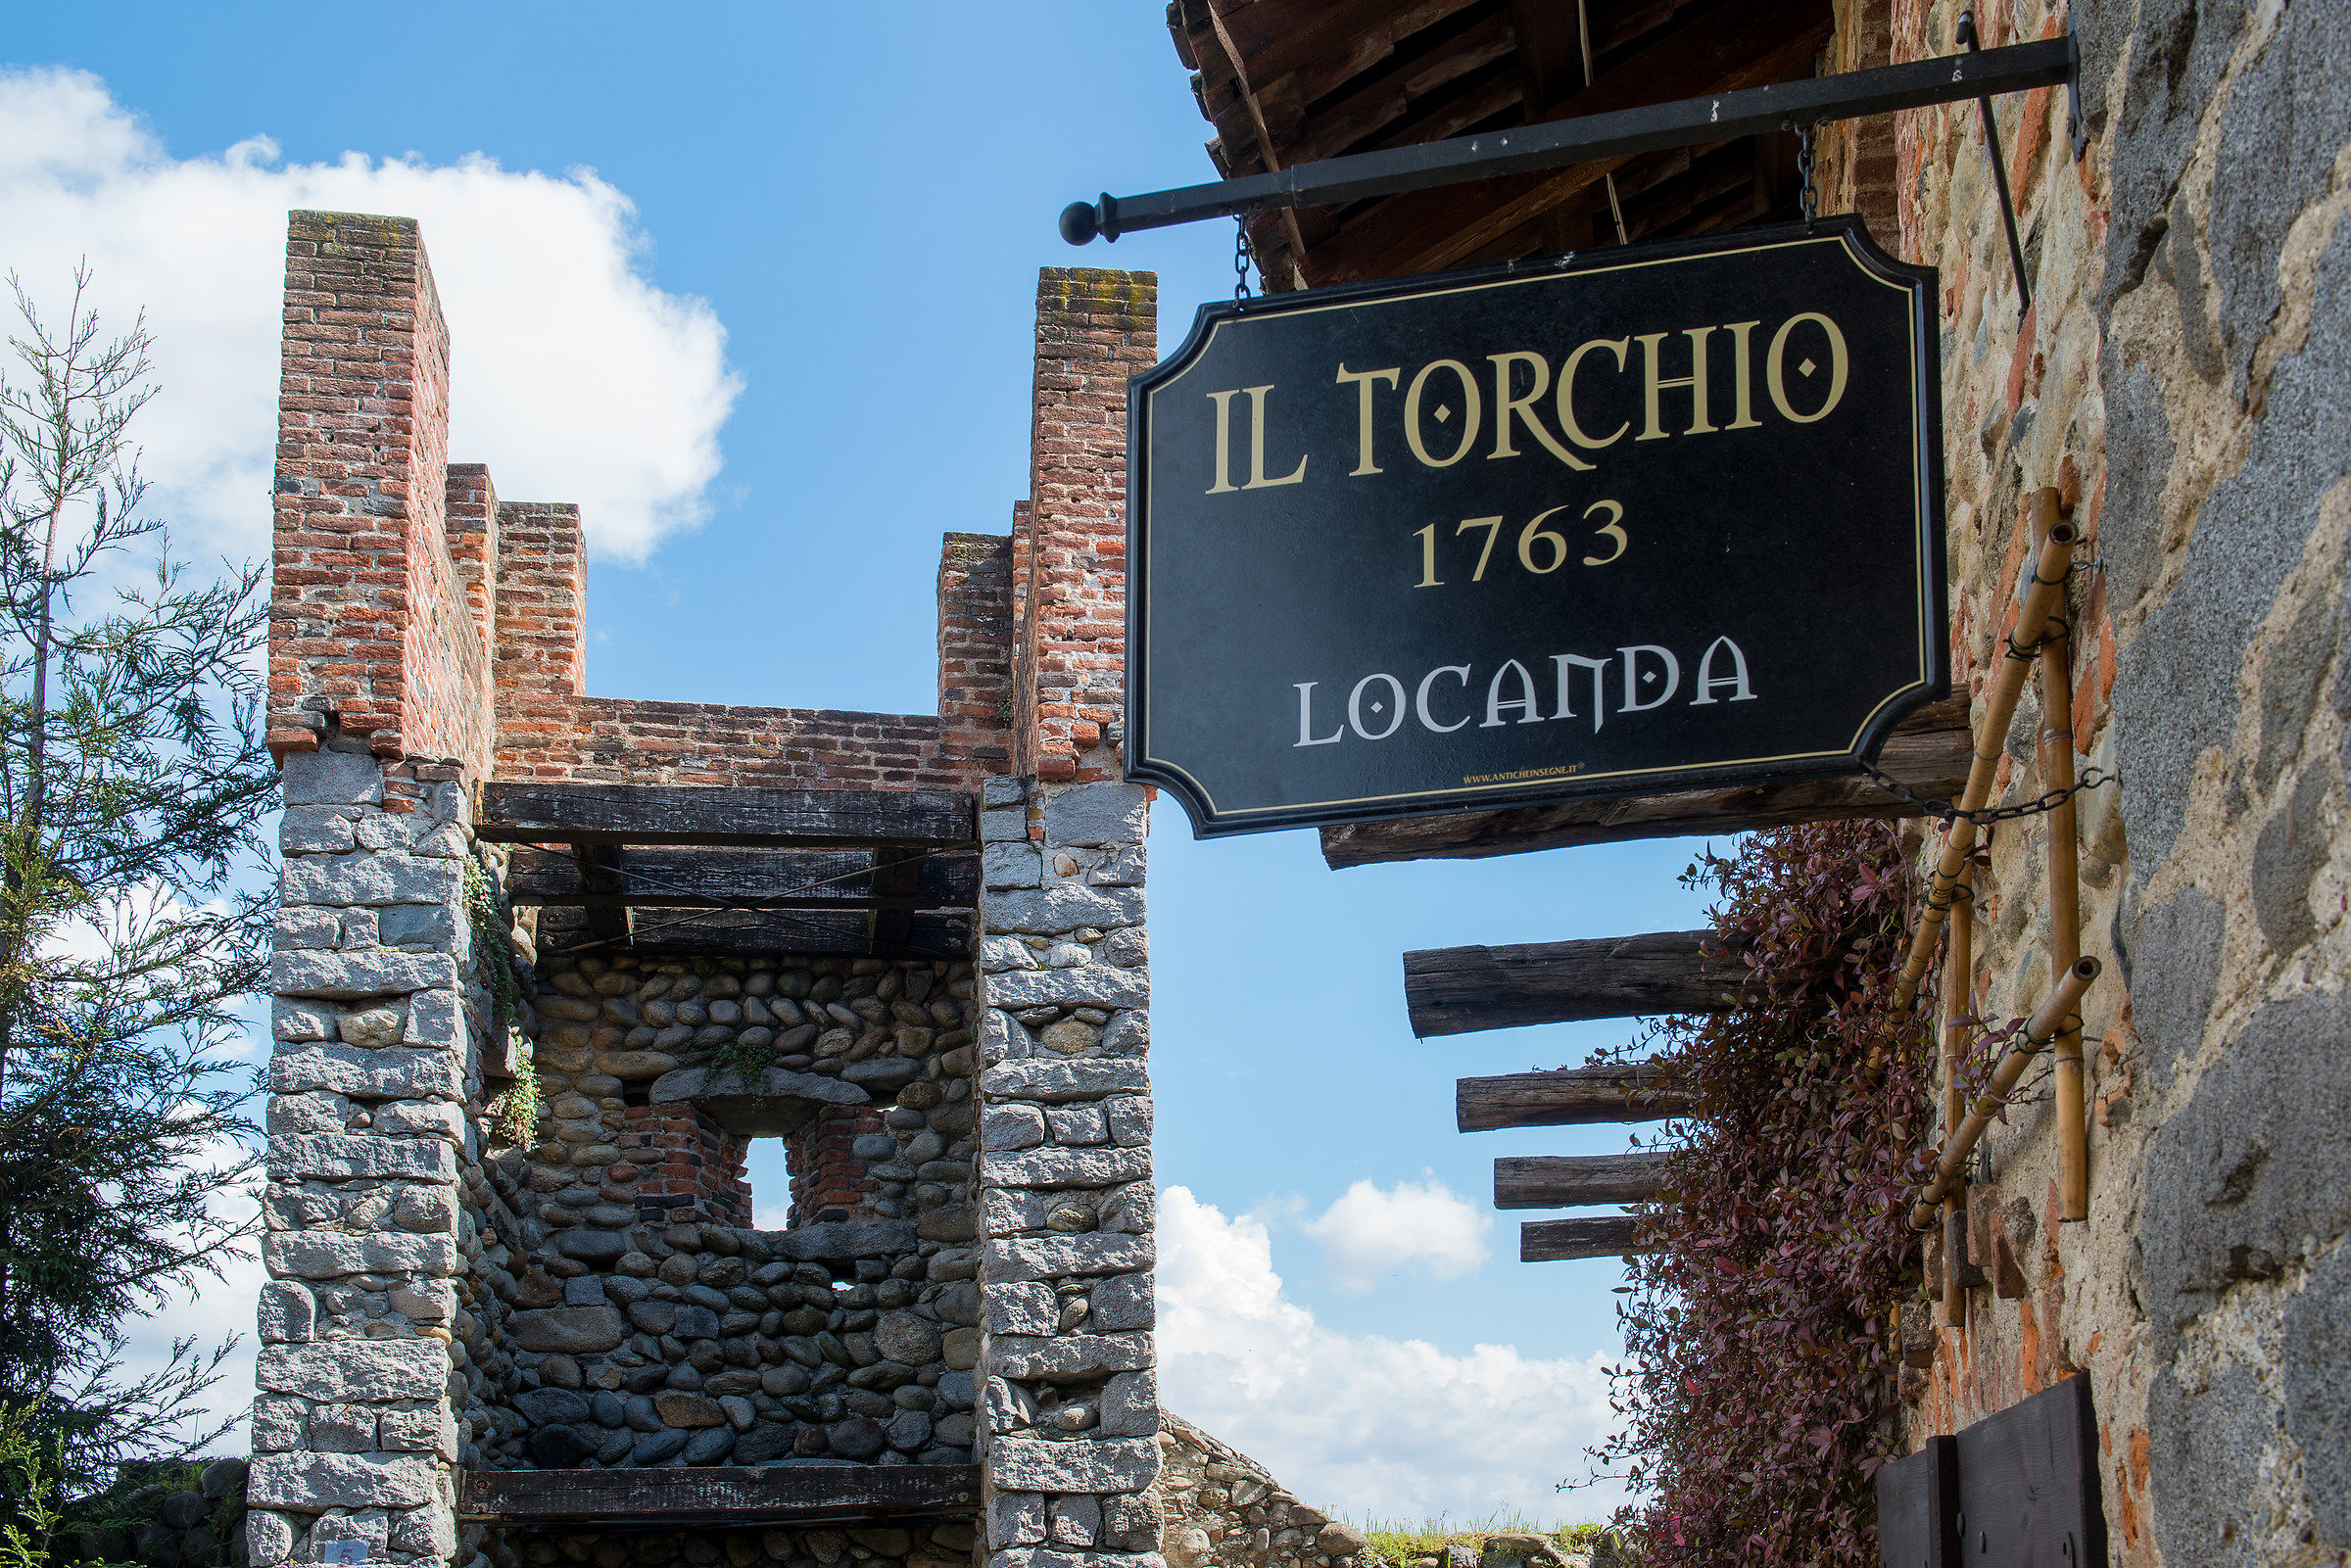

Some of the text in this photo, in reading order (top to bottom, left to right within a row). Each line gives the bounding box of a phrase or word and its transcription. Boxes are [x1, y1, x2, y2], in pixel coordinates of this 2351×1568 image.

[1205, 312, 1848, 495] IL TORCHIO
[1413, 499, 1628, 589] 1763
[1292, 635, 1758, 747] LOCANDA
